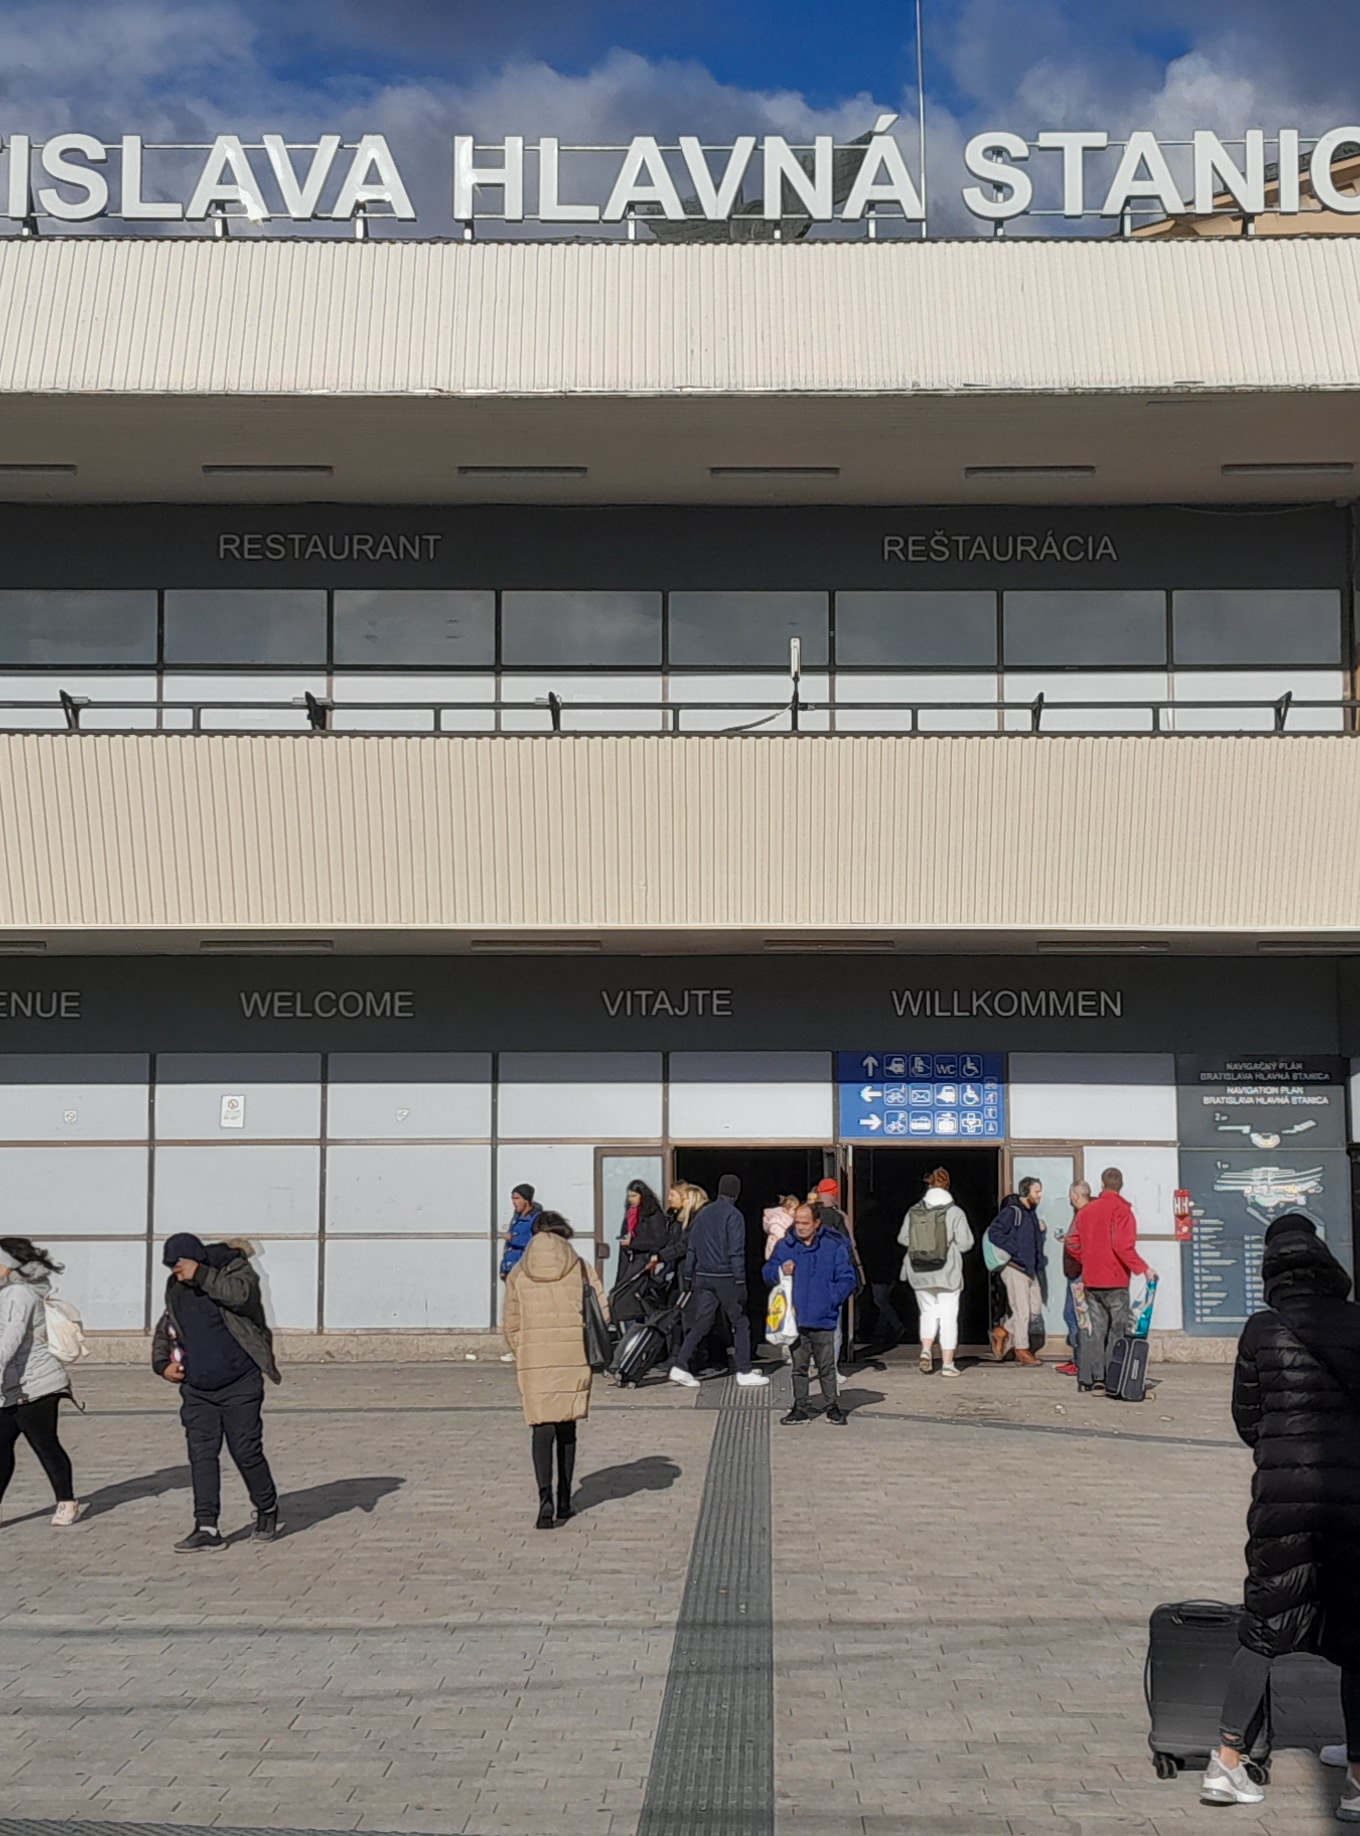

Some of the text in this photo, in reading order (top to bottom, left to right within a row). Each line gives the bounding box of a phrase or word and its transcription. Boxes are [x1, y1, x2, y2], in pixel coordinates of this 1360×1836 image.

[453, 114, 926, 222] HLAVNÁ
[217, 532, 443, 562] RESTAURANT
[882, 527, 1118, 563] REŠTAURÁCIA
[240, 990, 415, 1019] WELCOME
[601, 988, 734, 1017] VITAJTE
[891, 989, 1123, 1018] WILLKOMMEN
[935, 1063, 956, 1075] WC
[1200, 1072, 1254, 1080] BRATISLAVA
[1202, 1096, 1254, 1105] BRATISLAVA
[1226, 1086, 1304, 1095] NAVIGATION PLAN
